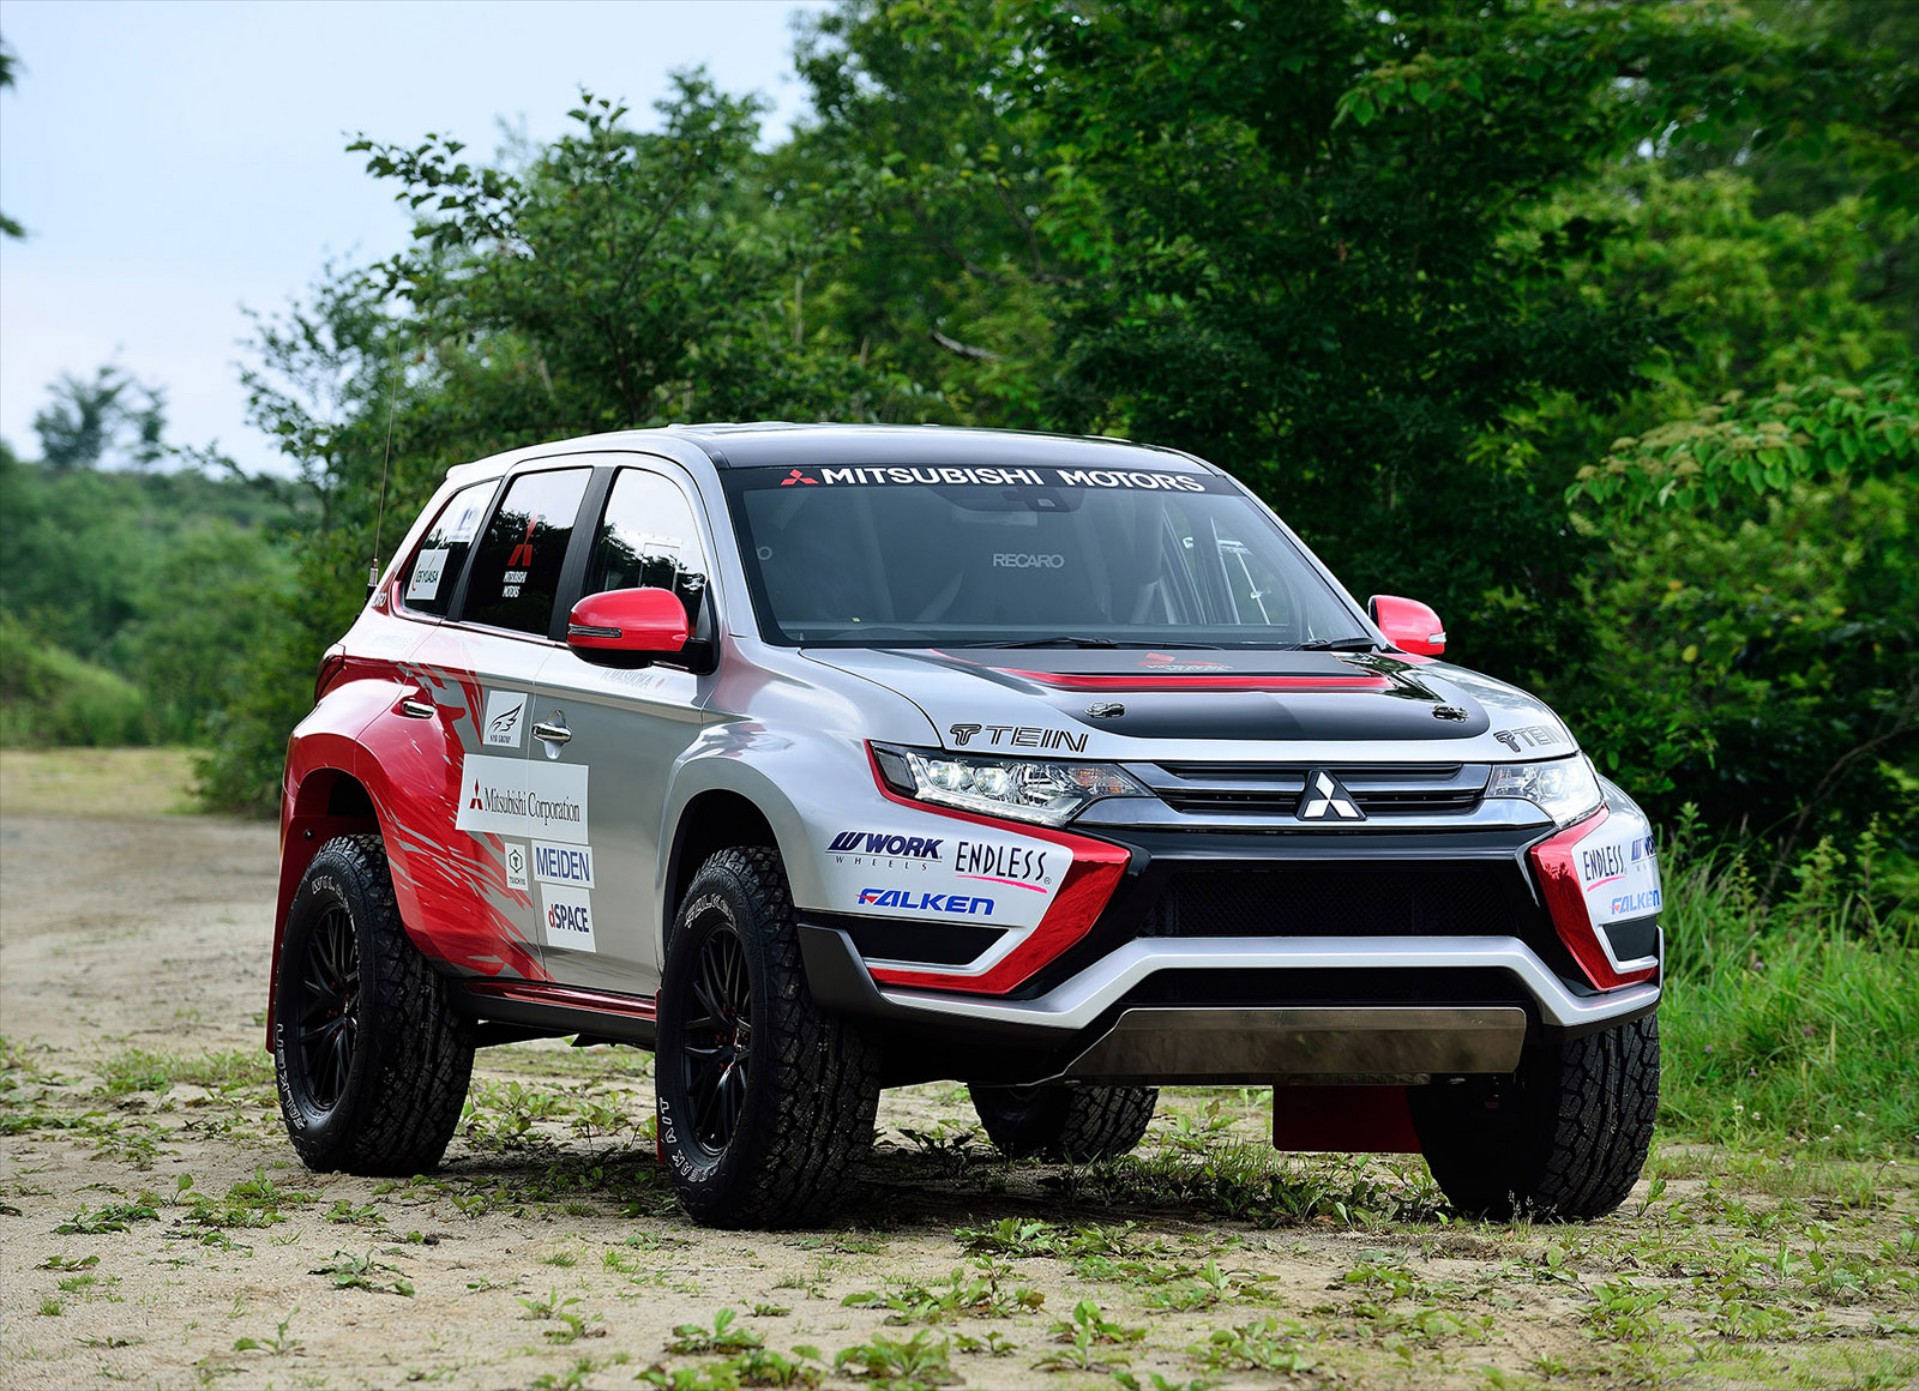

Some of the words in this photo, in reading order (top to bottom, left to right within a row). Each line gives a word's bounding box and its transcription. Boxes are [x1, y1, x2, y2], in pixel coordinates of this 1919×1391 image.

[821, 468, 1045, 486] MITSUBISHI
[1056, 469, 1206, 493] MOTORS
[992, 553, 1065, 570] RECARO
[986, 724, 1089, 753] TEIN
[484, 787, 527, 816] Mitsubishi
[528, 791, 581, 826] Corporation
[865, 833, 944, 859] WORK
[535, 847, 591, 882] MEIDEN
[835, 855, 928, 871] WHEELS
[955, 841, 1047, 881] ENDLESS
[1582, 844, 1625, 881] ENDLESS
[856, 887, 995, 916] FALKEN
[1610, 889, 1660, 915] FALKEN
[548, 903, 590, 933] dSPACE
